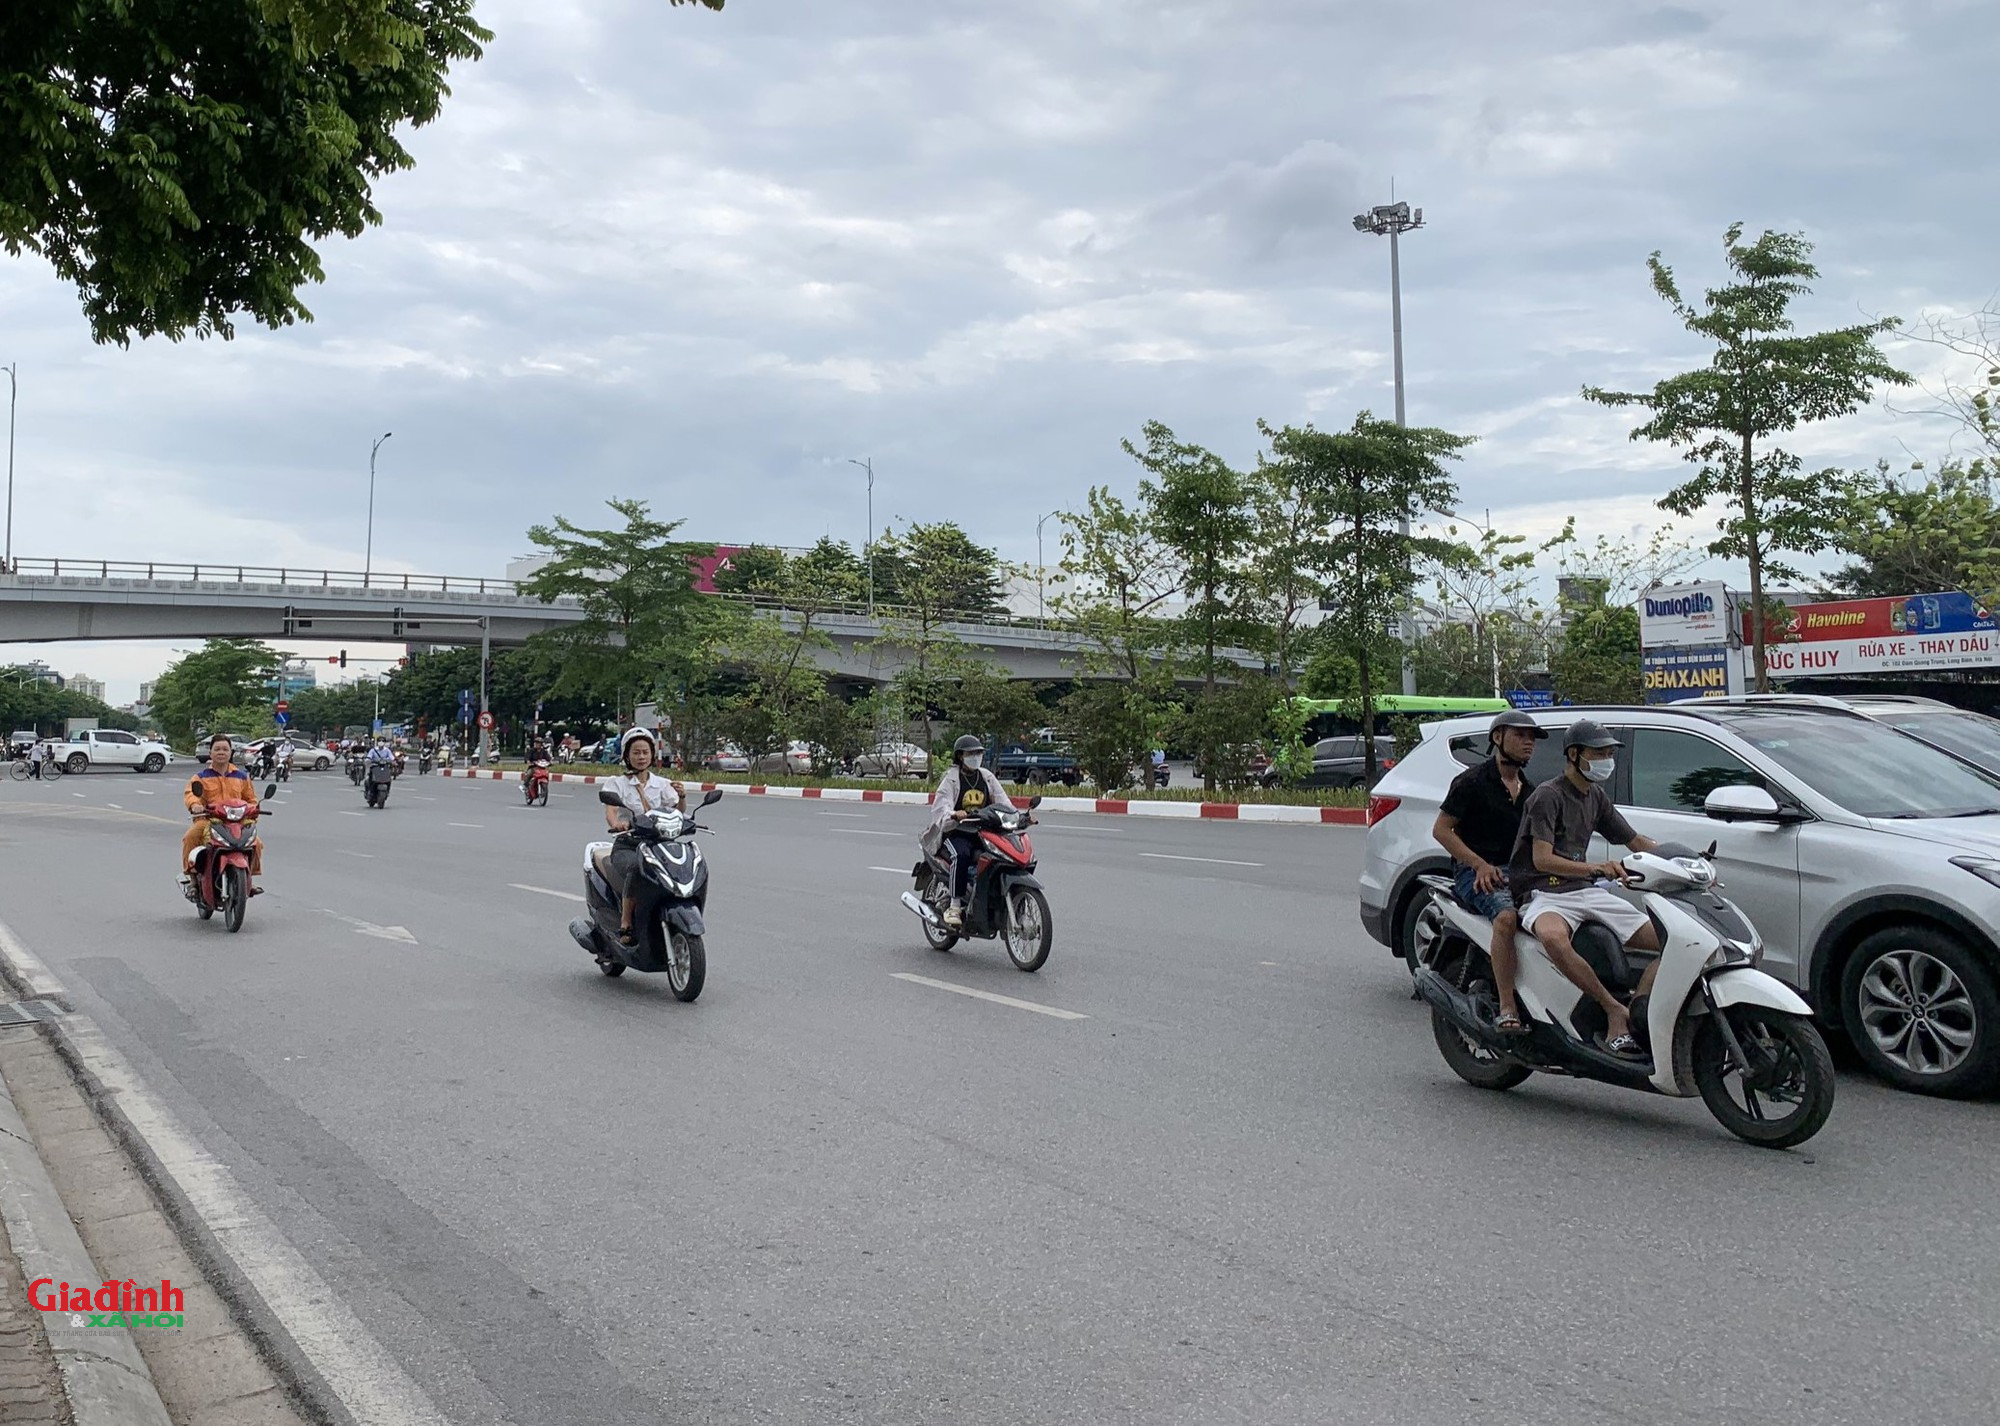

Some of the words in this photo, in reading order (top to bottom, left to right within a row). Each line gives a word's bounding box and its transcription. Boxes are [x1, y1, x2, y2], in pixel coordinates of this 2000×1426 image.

[1645, 592, 1713, 618] Dunlopillo
[1807, 610, 1866, 628] Havoline
[1859, 640, 1886, 658] RỬA
[1889, 642, 1906, 656] XE
[1918, 639, 1955, 654] THAY
[1801, 650, 1839, 668] HUY
